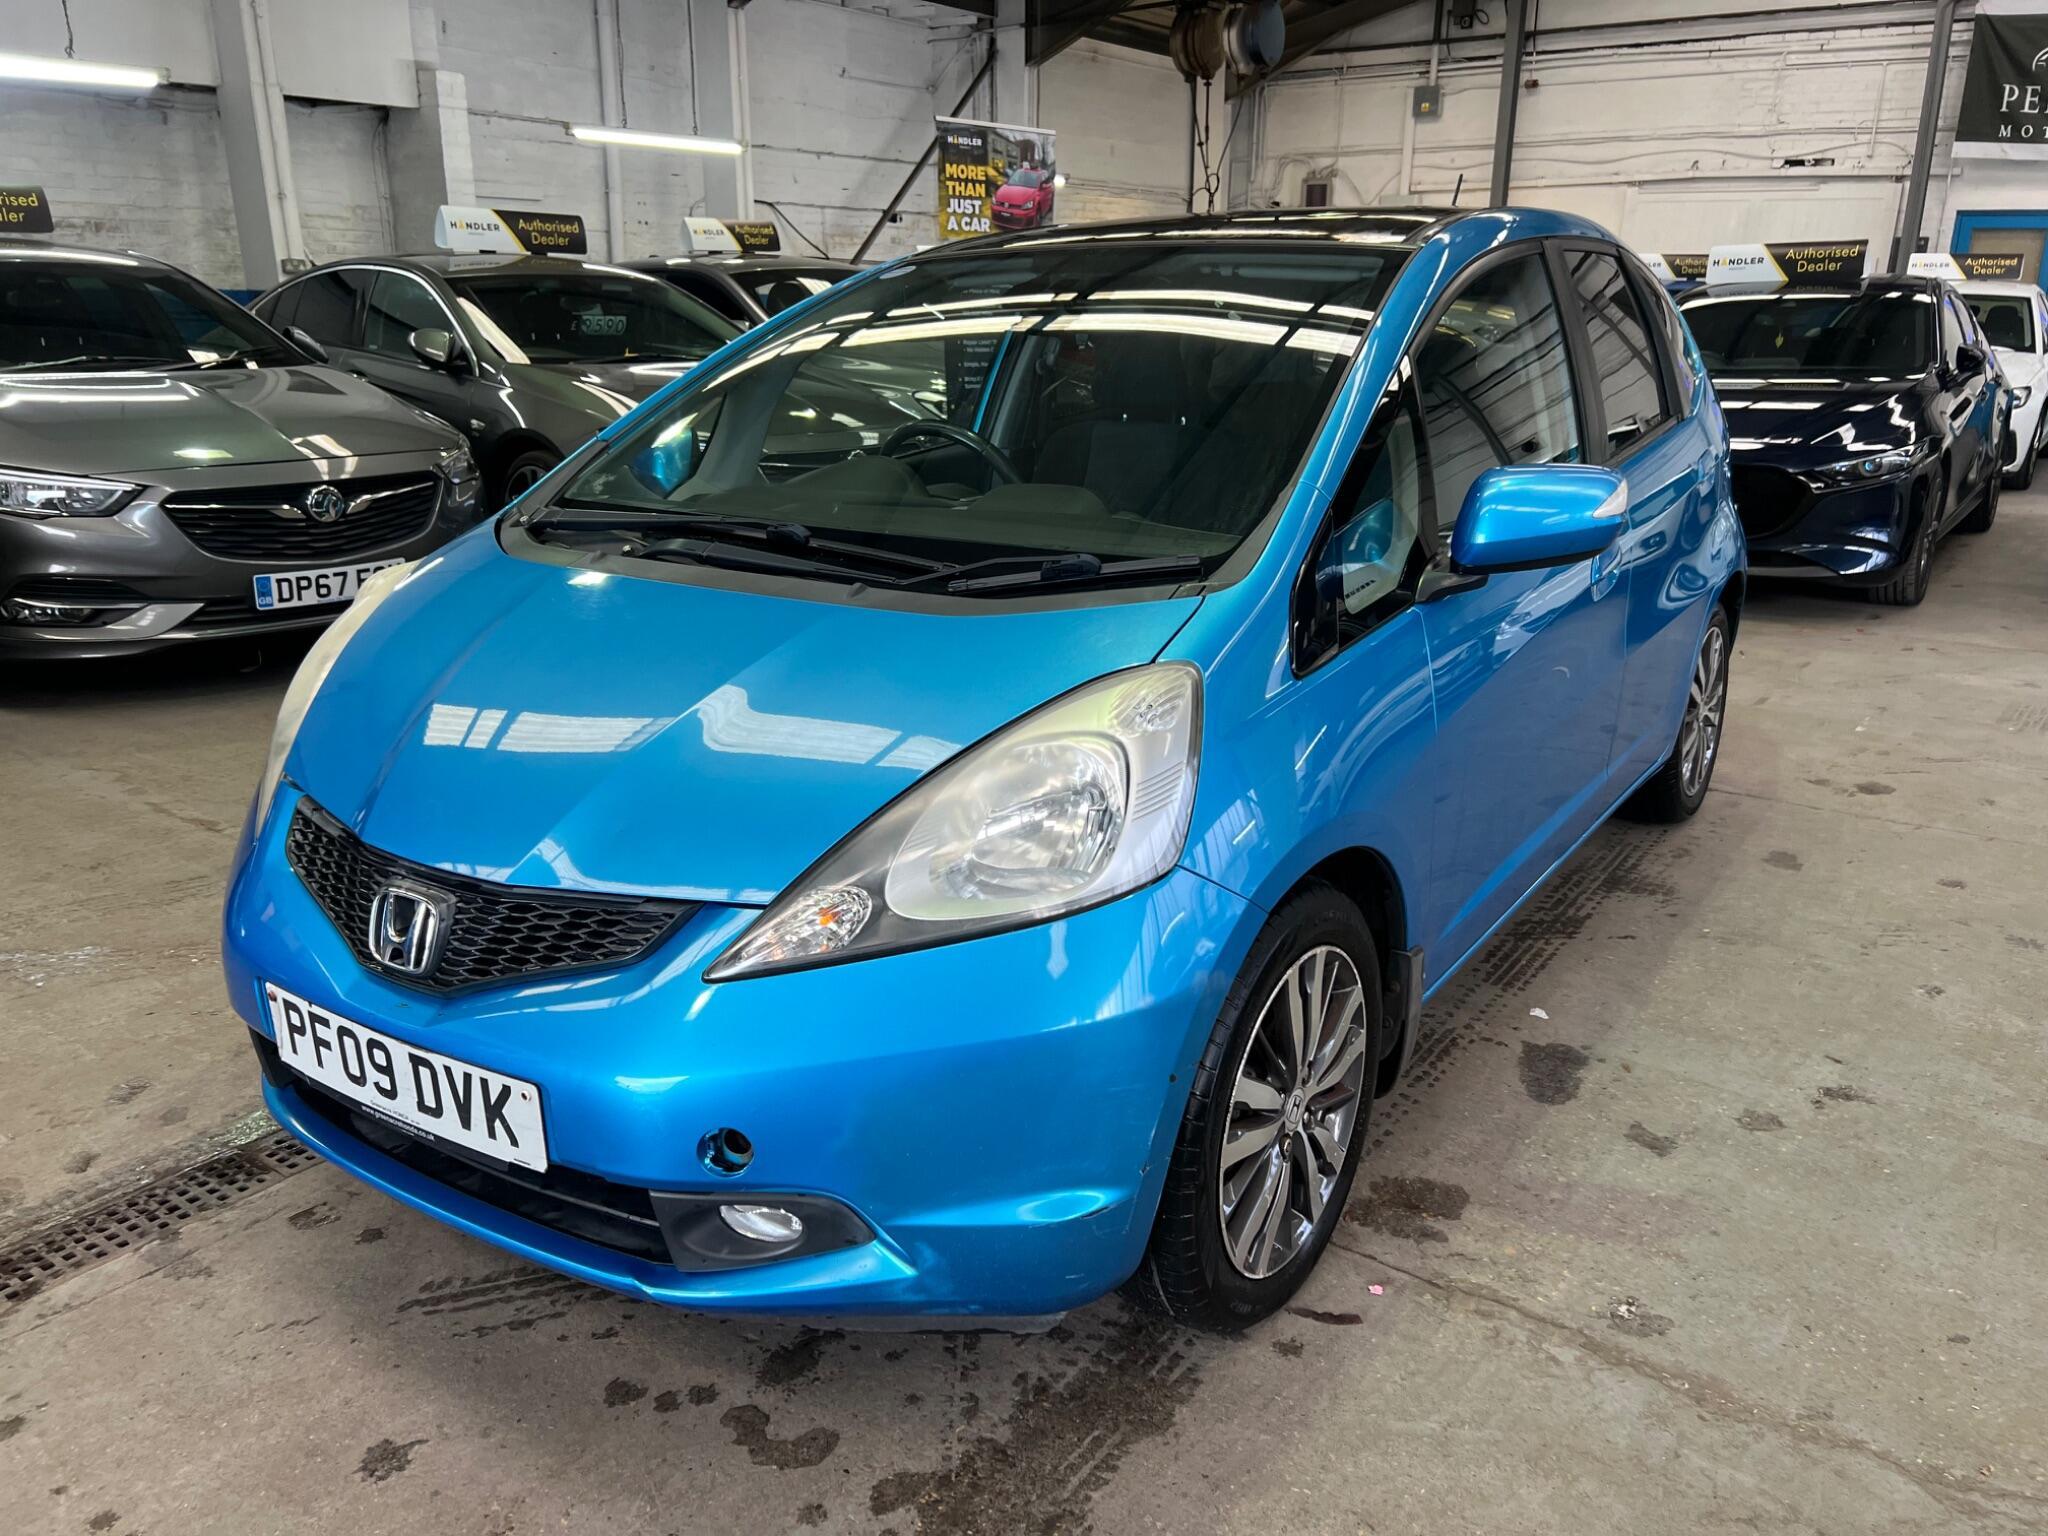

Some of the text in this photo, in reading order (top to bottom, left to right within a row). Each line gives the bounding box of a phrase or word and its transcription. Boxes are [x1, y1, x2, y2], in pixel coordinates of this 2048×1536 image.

[1999, 83, 2048, 114] PE
[945, 163, 986, 180] MORE
[945, 181, 986, 197] THAN
[946, 198, 982, 214] JUST
[518, 218, 580, 234] Authorised
[734, 223, 774, 235] Authorised
[947, 216, 990, 232] A CAR
[531, 231, 570, 246] Dealer
[744, 234, 768, 245] Dealer
[1785, 245, 1860, 260] Authorised
[1797, 259, 1842, 273] Dealer
[1965, 257, 2018, 266] Authorised
[1973, 265, 2006, 275] Dealer
[275, 570, 349, 603] DP67
[258, 595, 273, 605] GB
[282, 997, 520, 1149] PF09 DVK
